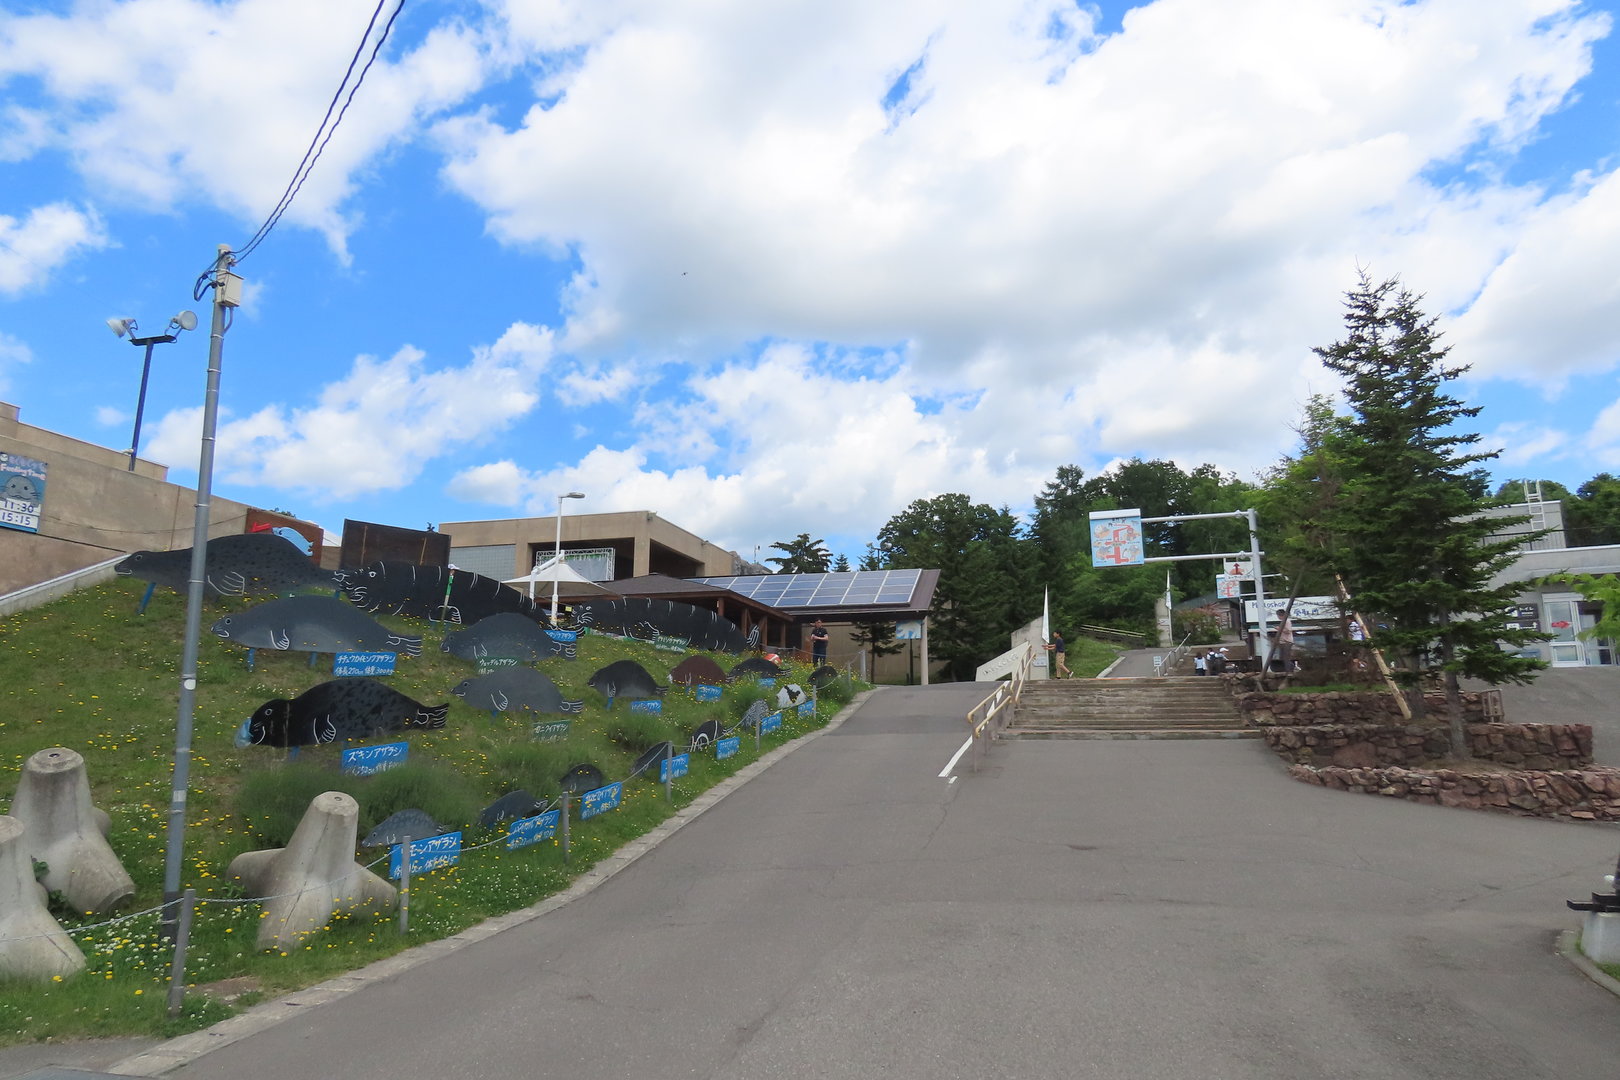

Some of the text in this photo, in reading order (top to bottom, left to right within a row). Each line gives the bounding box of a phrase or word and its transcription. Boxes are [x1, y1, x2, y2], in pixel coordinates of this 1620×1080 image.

[4, 501, 34, 513] 11:30
[2, 512, 31, 525] 15:15
[347, 745, 402, 763] ズキンアザラシ
